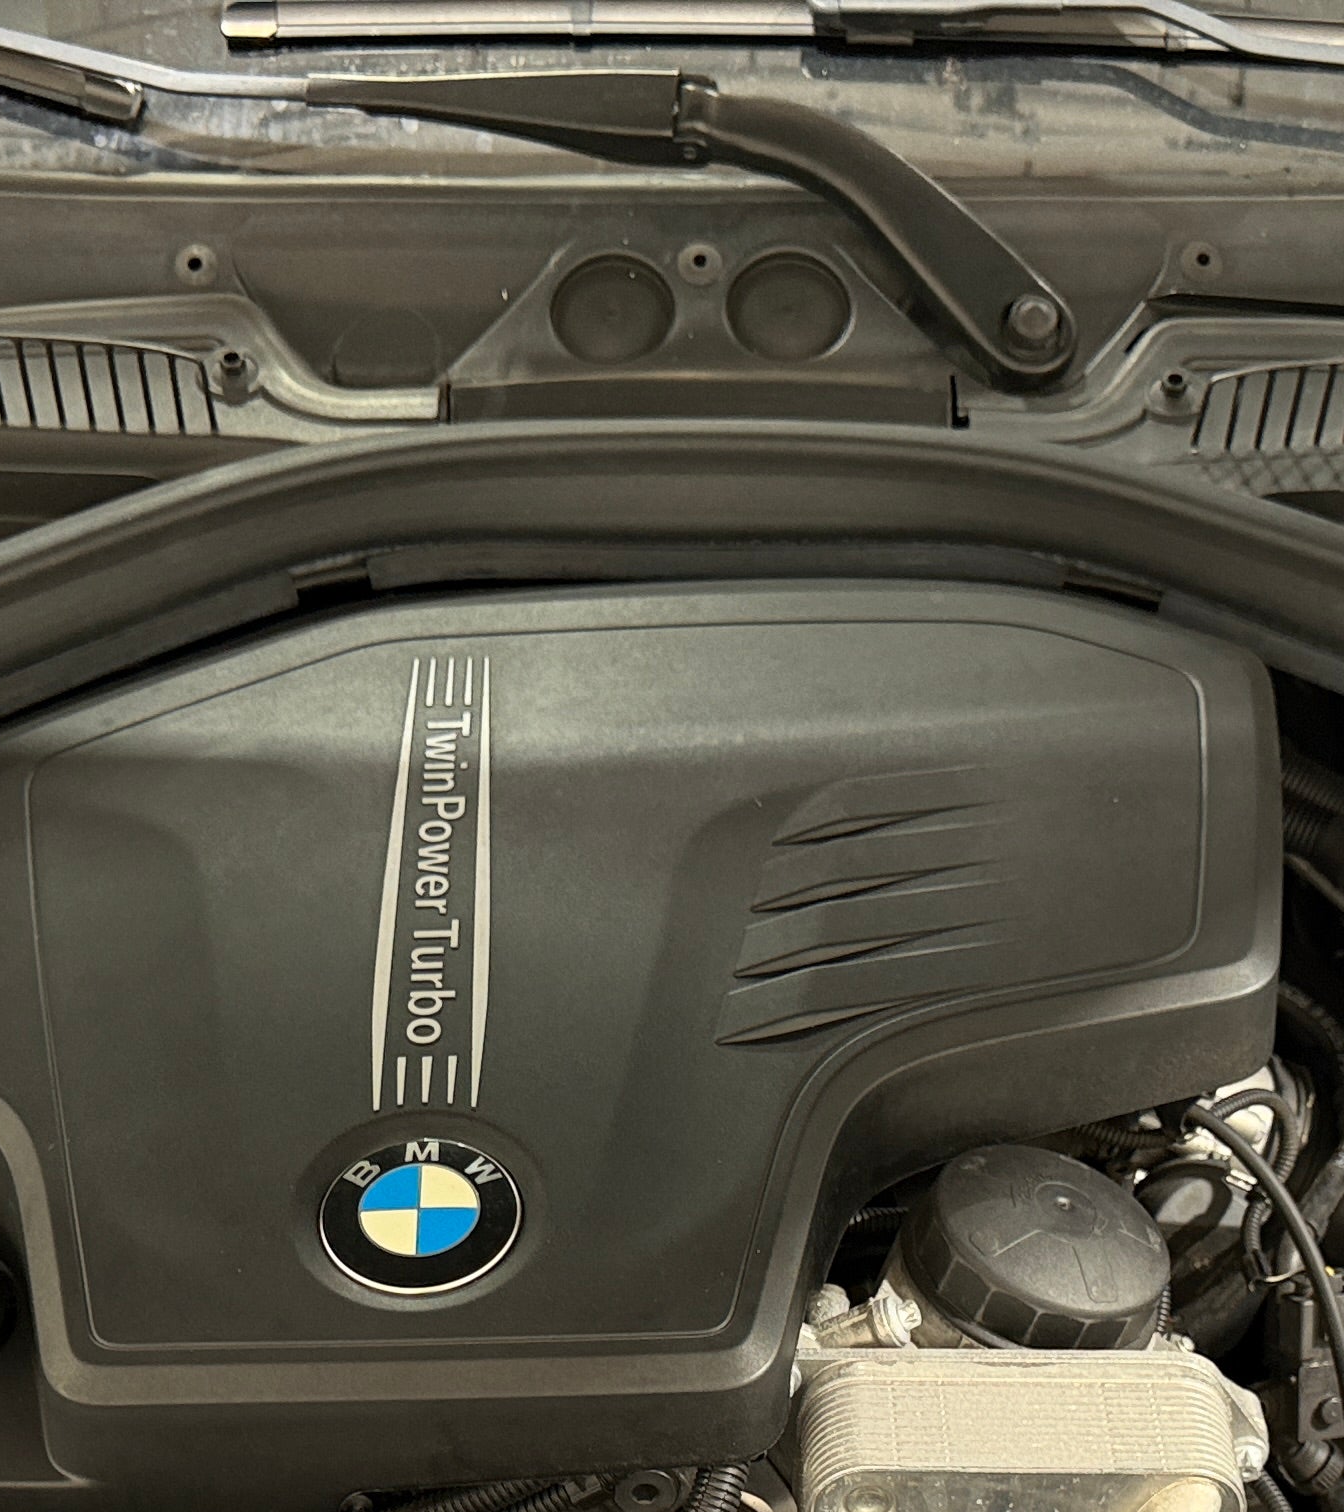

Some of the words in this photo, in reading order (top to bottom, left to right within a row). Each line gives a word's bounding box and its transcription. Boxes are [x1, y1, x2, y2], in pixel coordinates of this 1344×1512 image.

[416, 711, 471, 912] TwinPower
[406, 919, 459, 1045] Turbo
[343, 1140, 503, 1188] BMW
